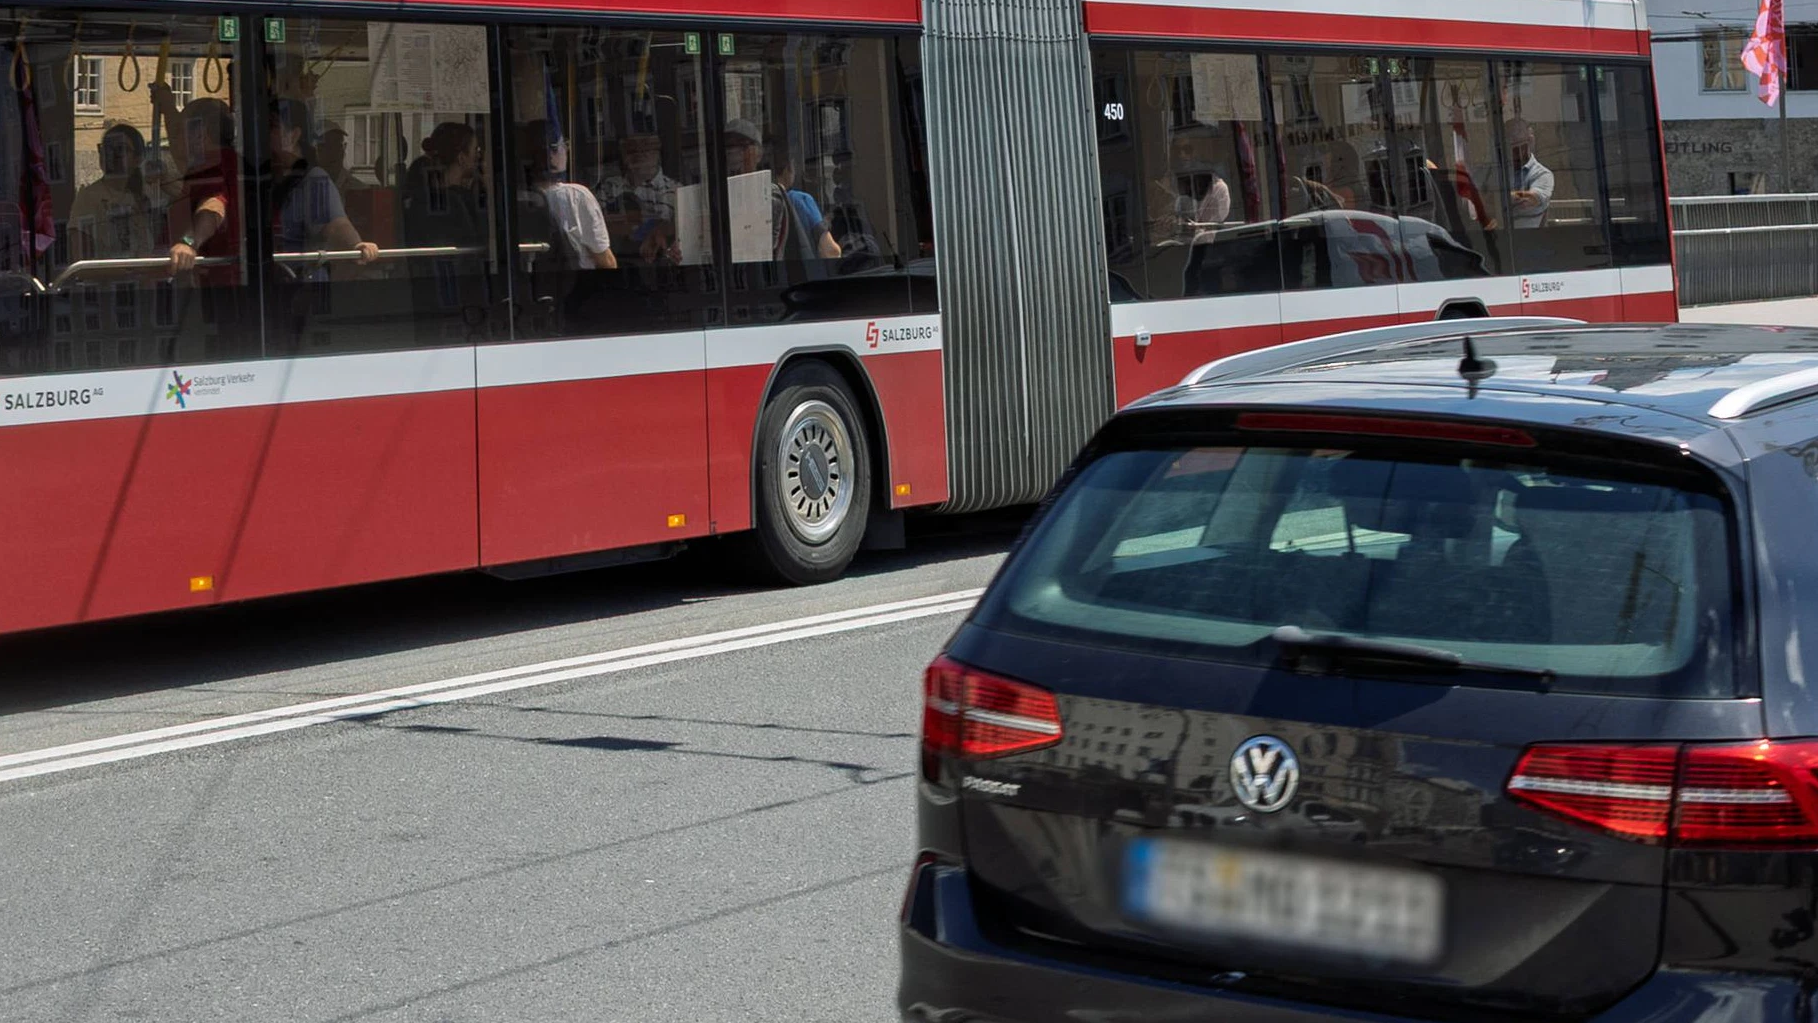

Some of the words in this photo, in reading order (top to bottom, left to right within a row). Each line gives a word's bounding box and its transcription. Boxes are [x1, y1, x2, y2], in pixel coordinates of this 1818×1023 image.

[1104, 103, 1124, 120] 450
[1666, 141, 1733, 154] EITLING
[1531, 281, 1561, 293] SALZBURG
[882, 326, 932, 342] SALZBURG
[194, 375, 226, 387] Salzburg
[226, 372, 255, 384] Verkehr
[5, 389, 91, 410] SALZBURG
[92, 388, 104, 396] AG
